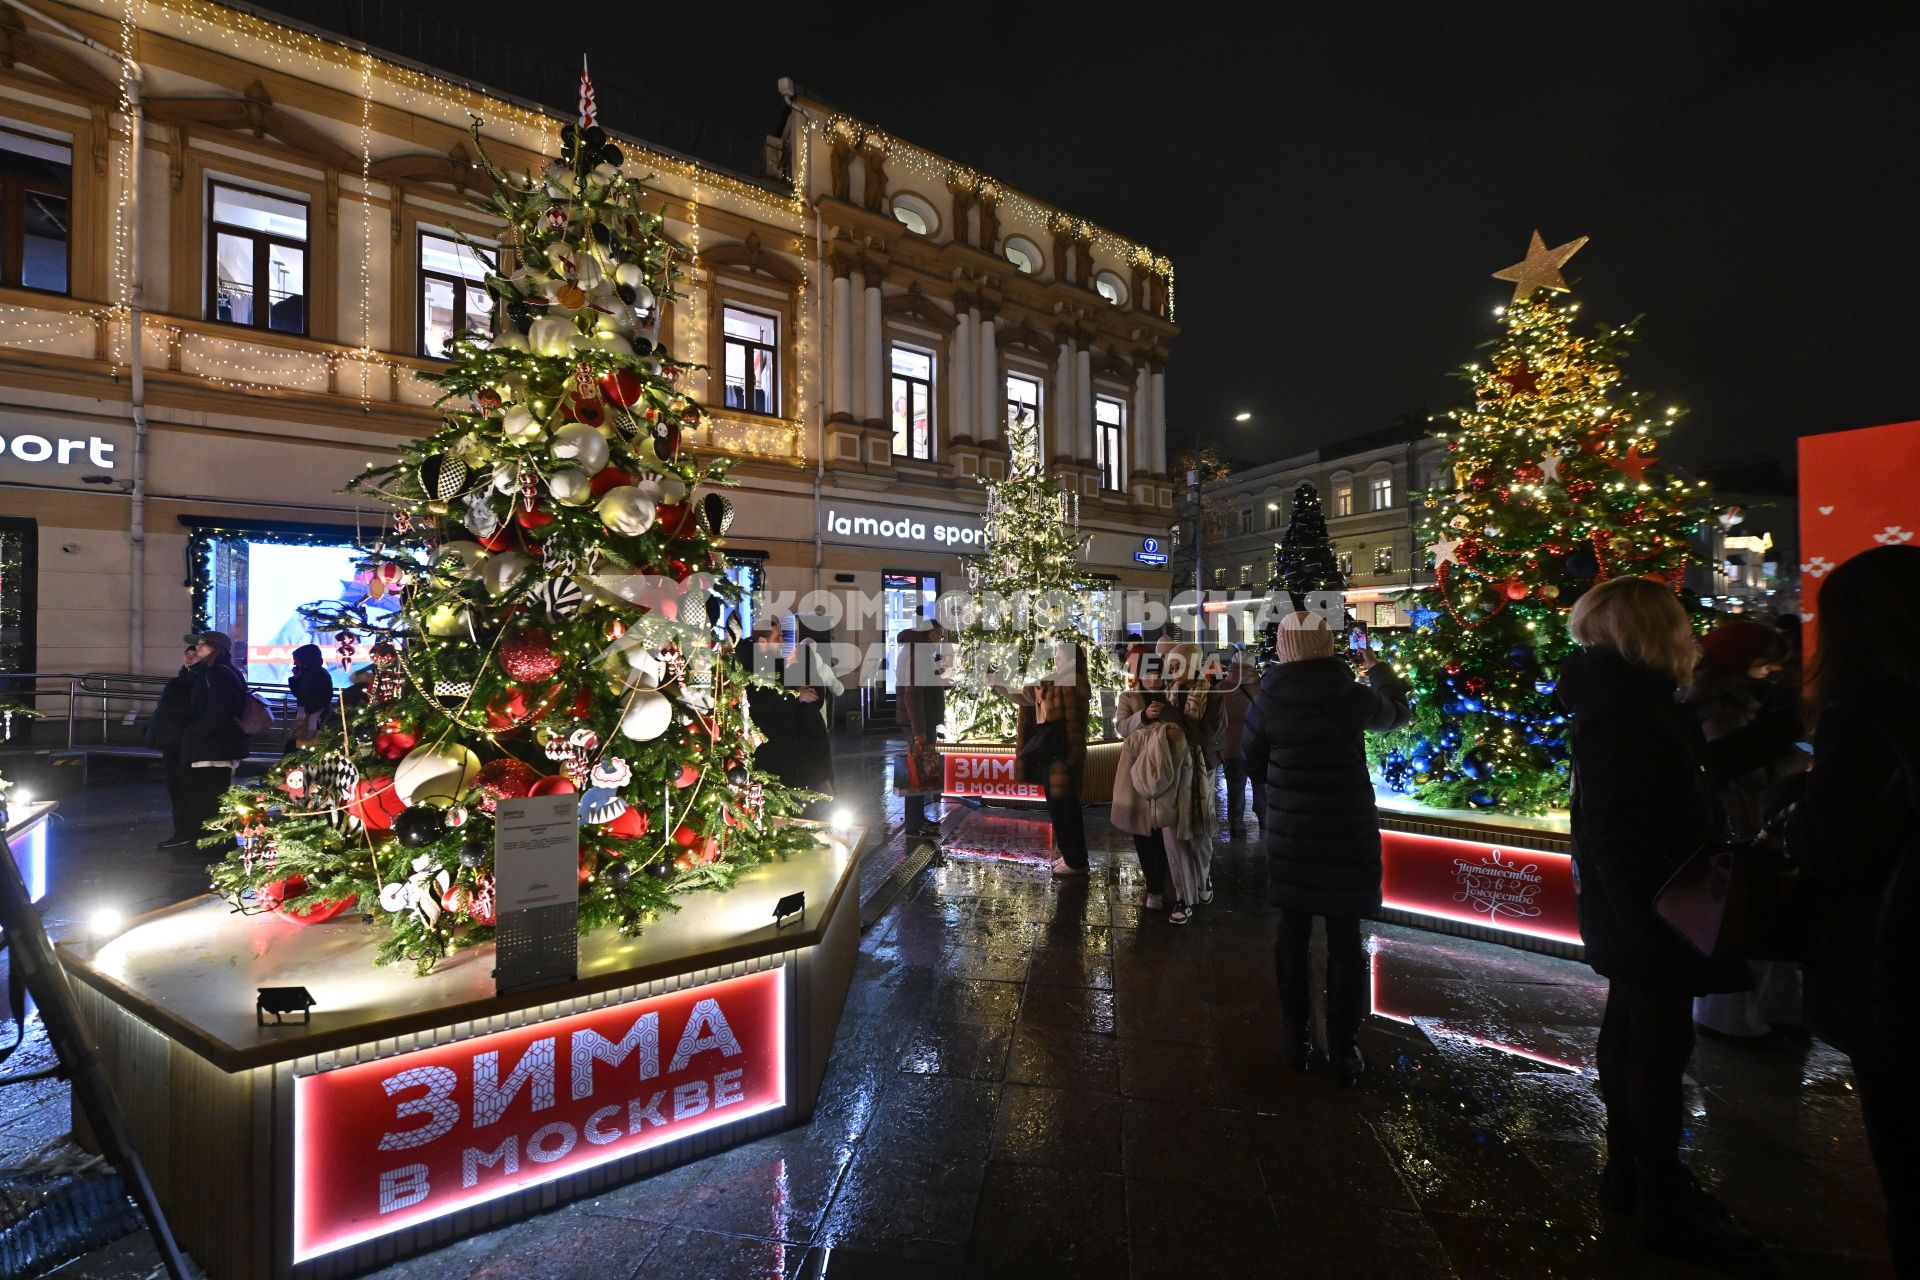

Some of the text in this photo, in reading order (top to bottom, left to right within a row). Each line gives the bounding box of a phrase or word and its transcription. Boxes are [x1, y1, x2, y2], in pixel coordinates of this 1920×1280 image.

[0, 434, 115, 469] ort
[827, 510, 926, 540] lamoda
[1148, 540, 1155, 551] 7
[954, 757, 1016, 780] ЗИМ
[955, 781, 1039, 797] В МОСКВЕ
[1453, 855, 1542, 883] Путешествие
[1454, 876, 1540, 912] Рождество
[377, 997, 742, 1152] ЗИМА
[379, 1067, 745, 1215] В МОСКВЕ
